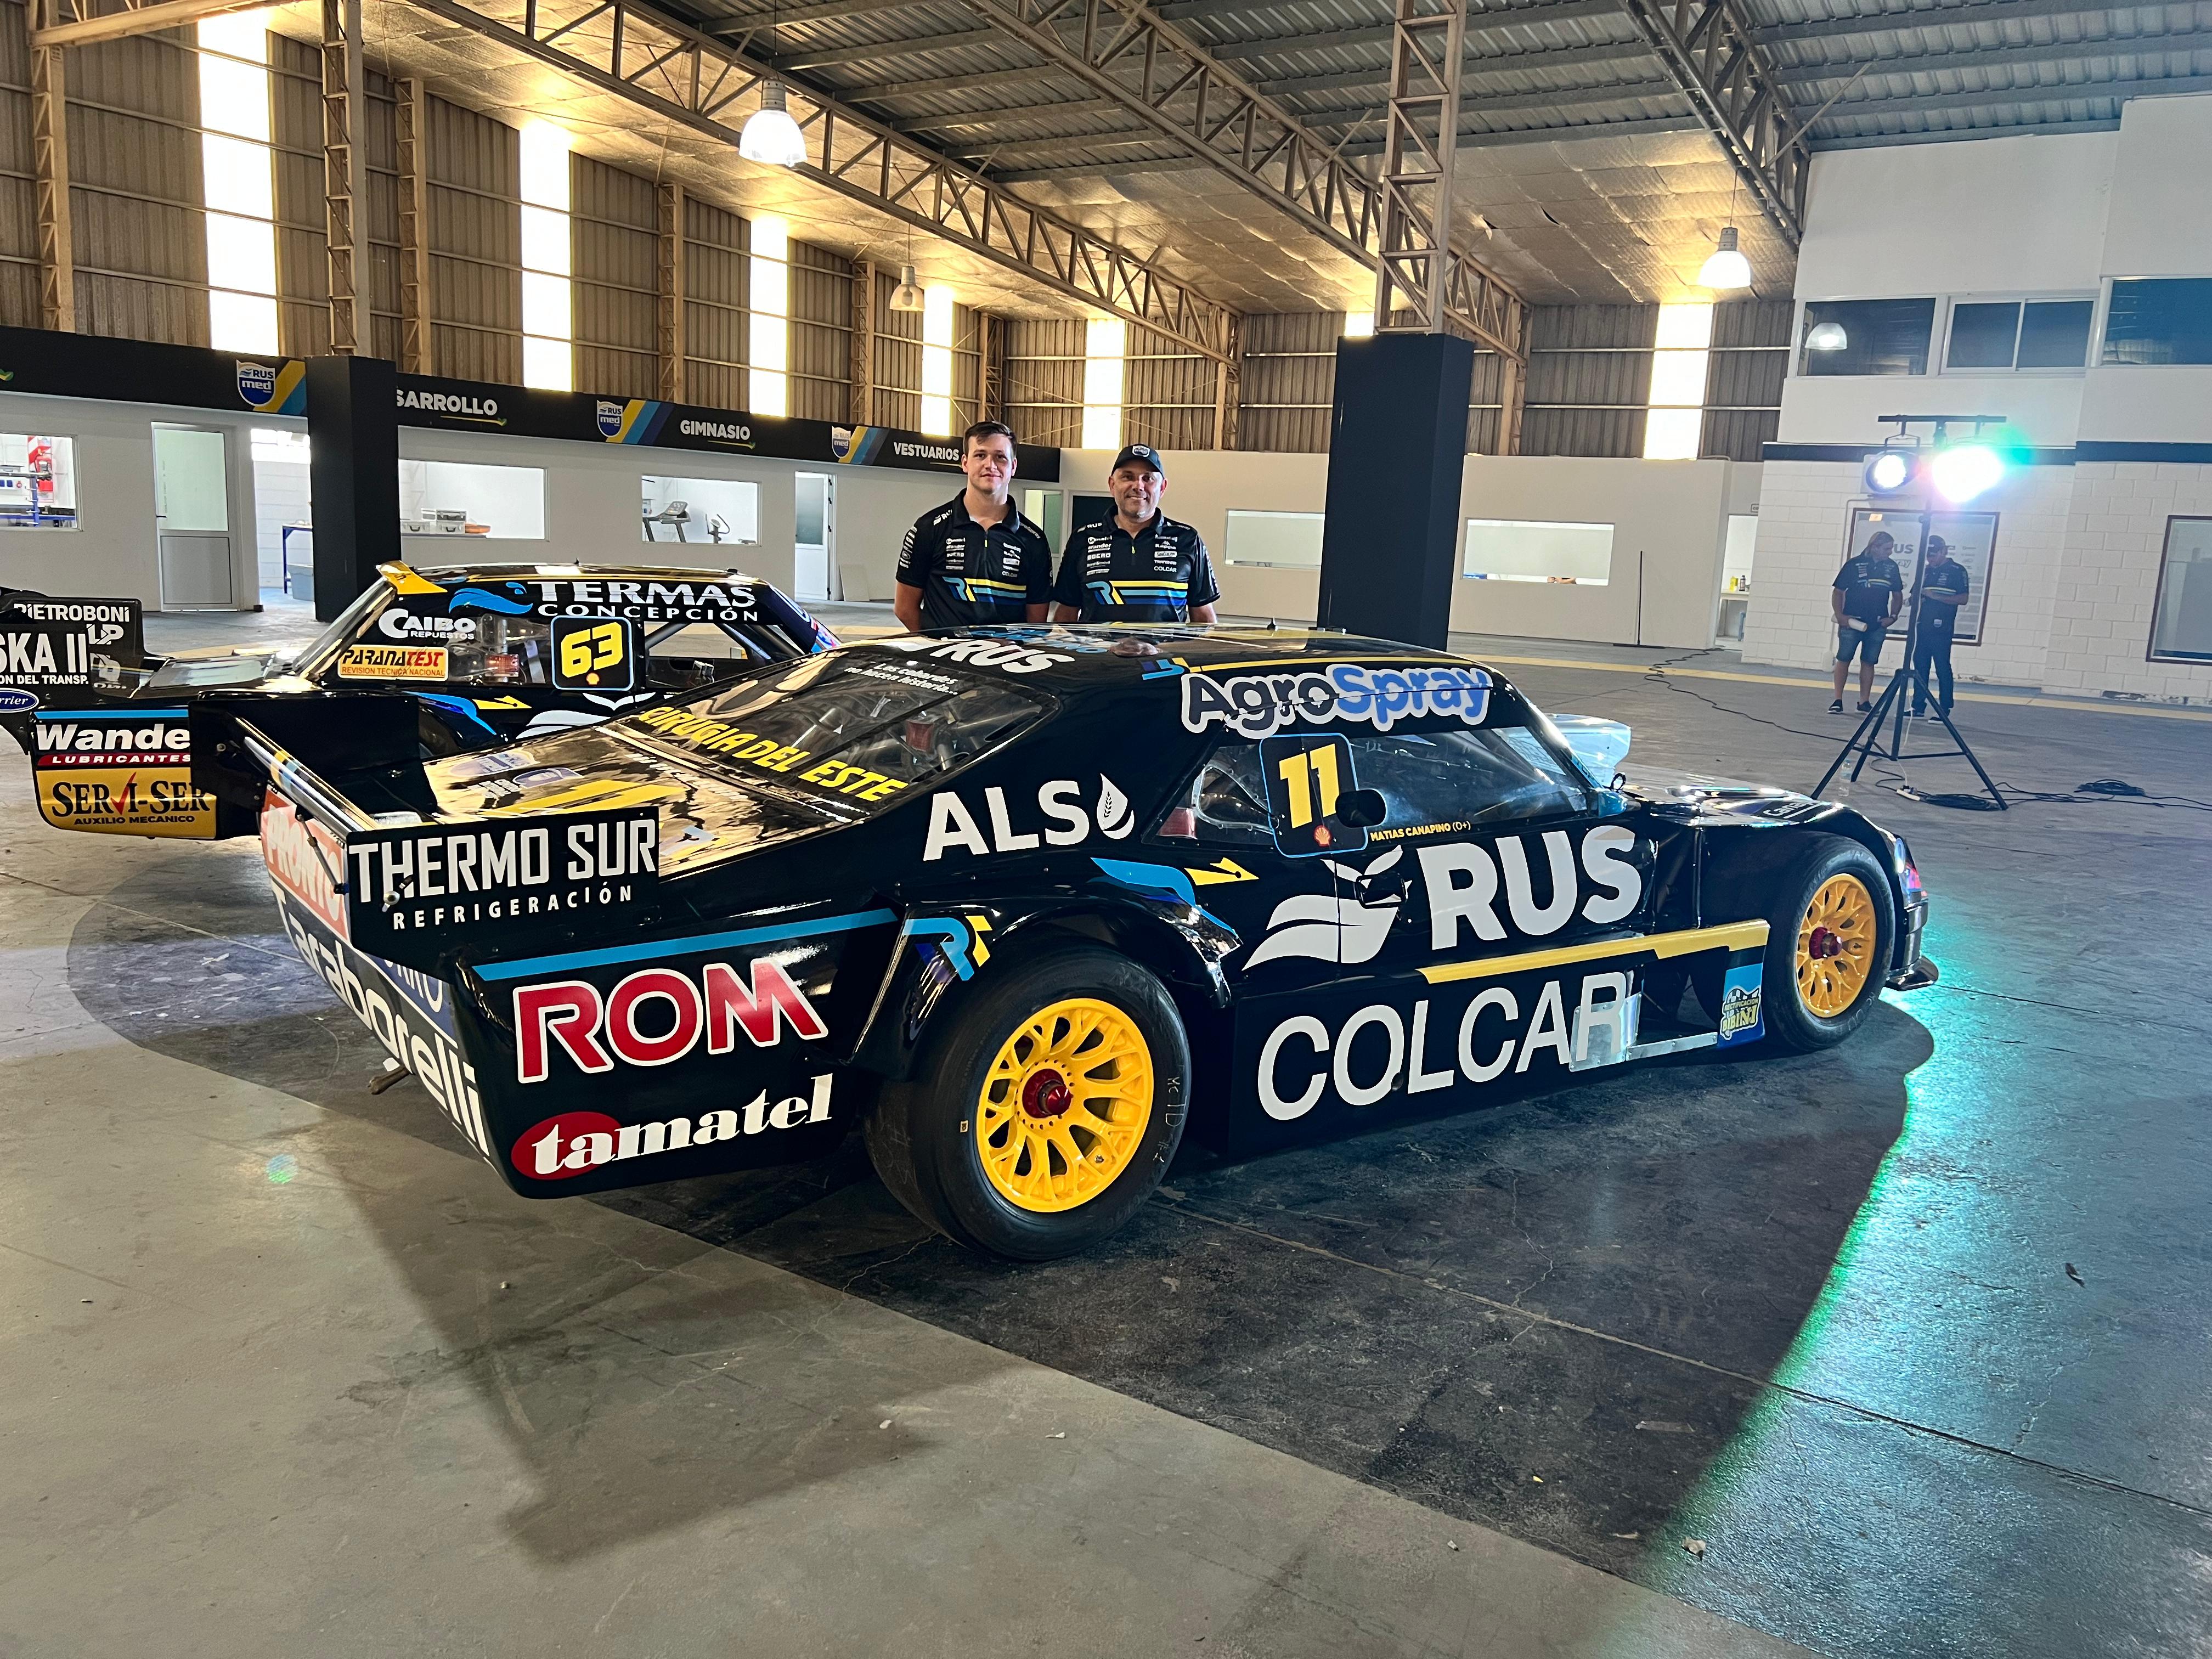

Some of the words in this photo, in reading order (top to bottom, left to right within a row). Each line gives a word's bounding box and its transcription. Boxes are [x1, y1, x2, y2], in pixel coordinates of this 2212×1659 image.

[242, 380, 271, 390] med
[253, 369, 274, 379] RUS
[600, 416, 620, 424] med
[680, 420, 751, 440] GIMNASIO
[893, 442, 960, 461] VESTUARIOS
[527, 581, 757, 608] TERMAS
[378, 608, 476, 639] CAIBO
[538, 603, 758, 622] CONCEPCIÓN
[410, 630, 475, 640] REPUESTOS
[561, 622, 623, 678] 63
[930, 639, 1075, 673] RUS
[17, 675, 39, 684] DEL
[42, 675, 89, 685] TRANSP.
[409, 669, 445, 677] NACIONAL
[1181, 664, 1492, 740] AgroSpray
[52, 754, 191, 764] LUBRICANTES
[639, 706, 749, 752] CIRUGIA
[732, 733, 811, 772] DEL
[798, 760, 909, 801] ESTE
[1279, 743, 1340, 830] 11
[74, 816, 126, 825] AUXILIO
[129, 815, 195, 824] MECANICO
[1370, 828, 1405, 842] MATIAS
[1405, 822, 1451, 837] CANAPINO
[267, 803, 342, 922] PRONTO
[348, 827, 549, 902] THERMO
[567, 819, 656, 880] SUR
[1417, 825, 1641, 950] RUS
[393, 881, 631, 930] REFRIGERACIÓN
[1724, 997, 1759, 1009] RECTIFICACION
[513, 958, 829, 1084] ROM
[1257, 971, 1628, 1120] COLCAR
[532, 1073, 833, 1175] tamatel
